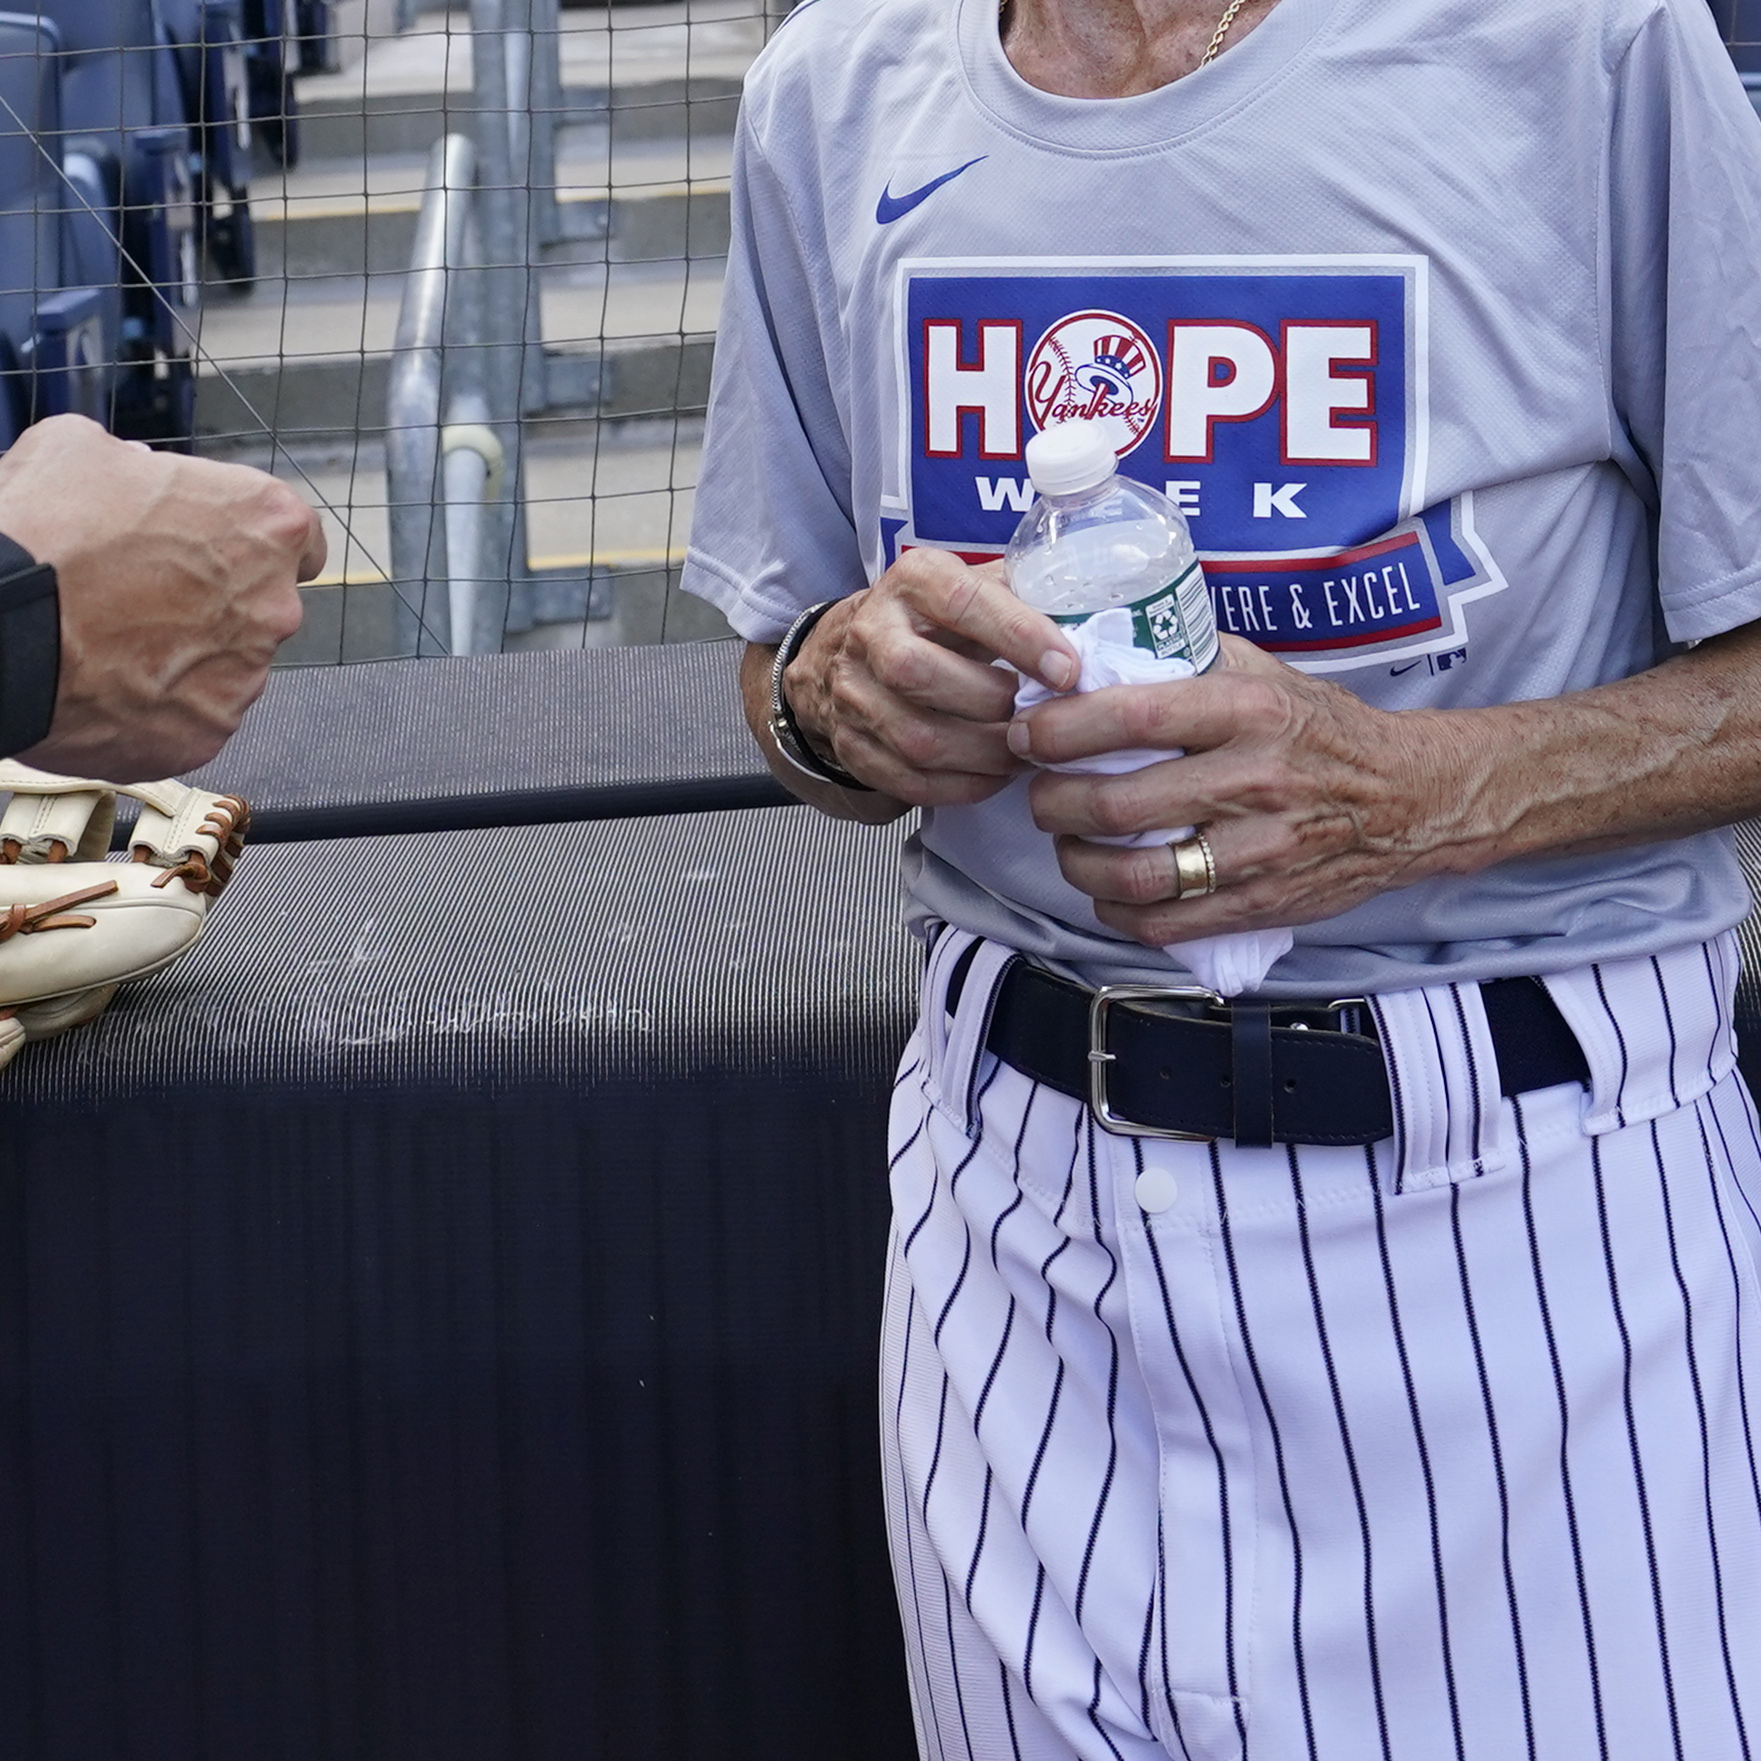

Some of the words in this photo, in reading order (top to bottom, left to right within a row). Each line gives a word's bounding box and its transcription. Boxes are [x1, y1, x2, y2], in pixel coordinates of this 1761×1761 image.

[1028, 360, 1157, 433] Yankees
[974, 476, 1309, 520] WEK
[1323, 562, 1421, 628] EXCEL
